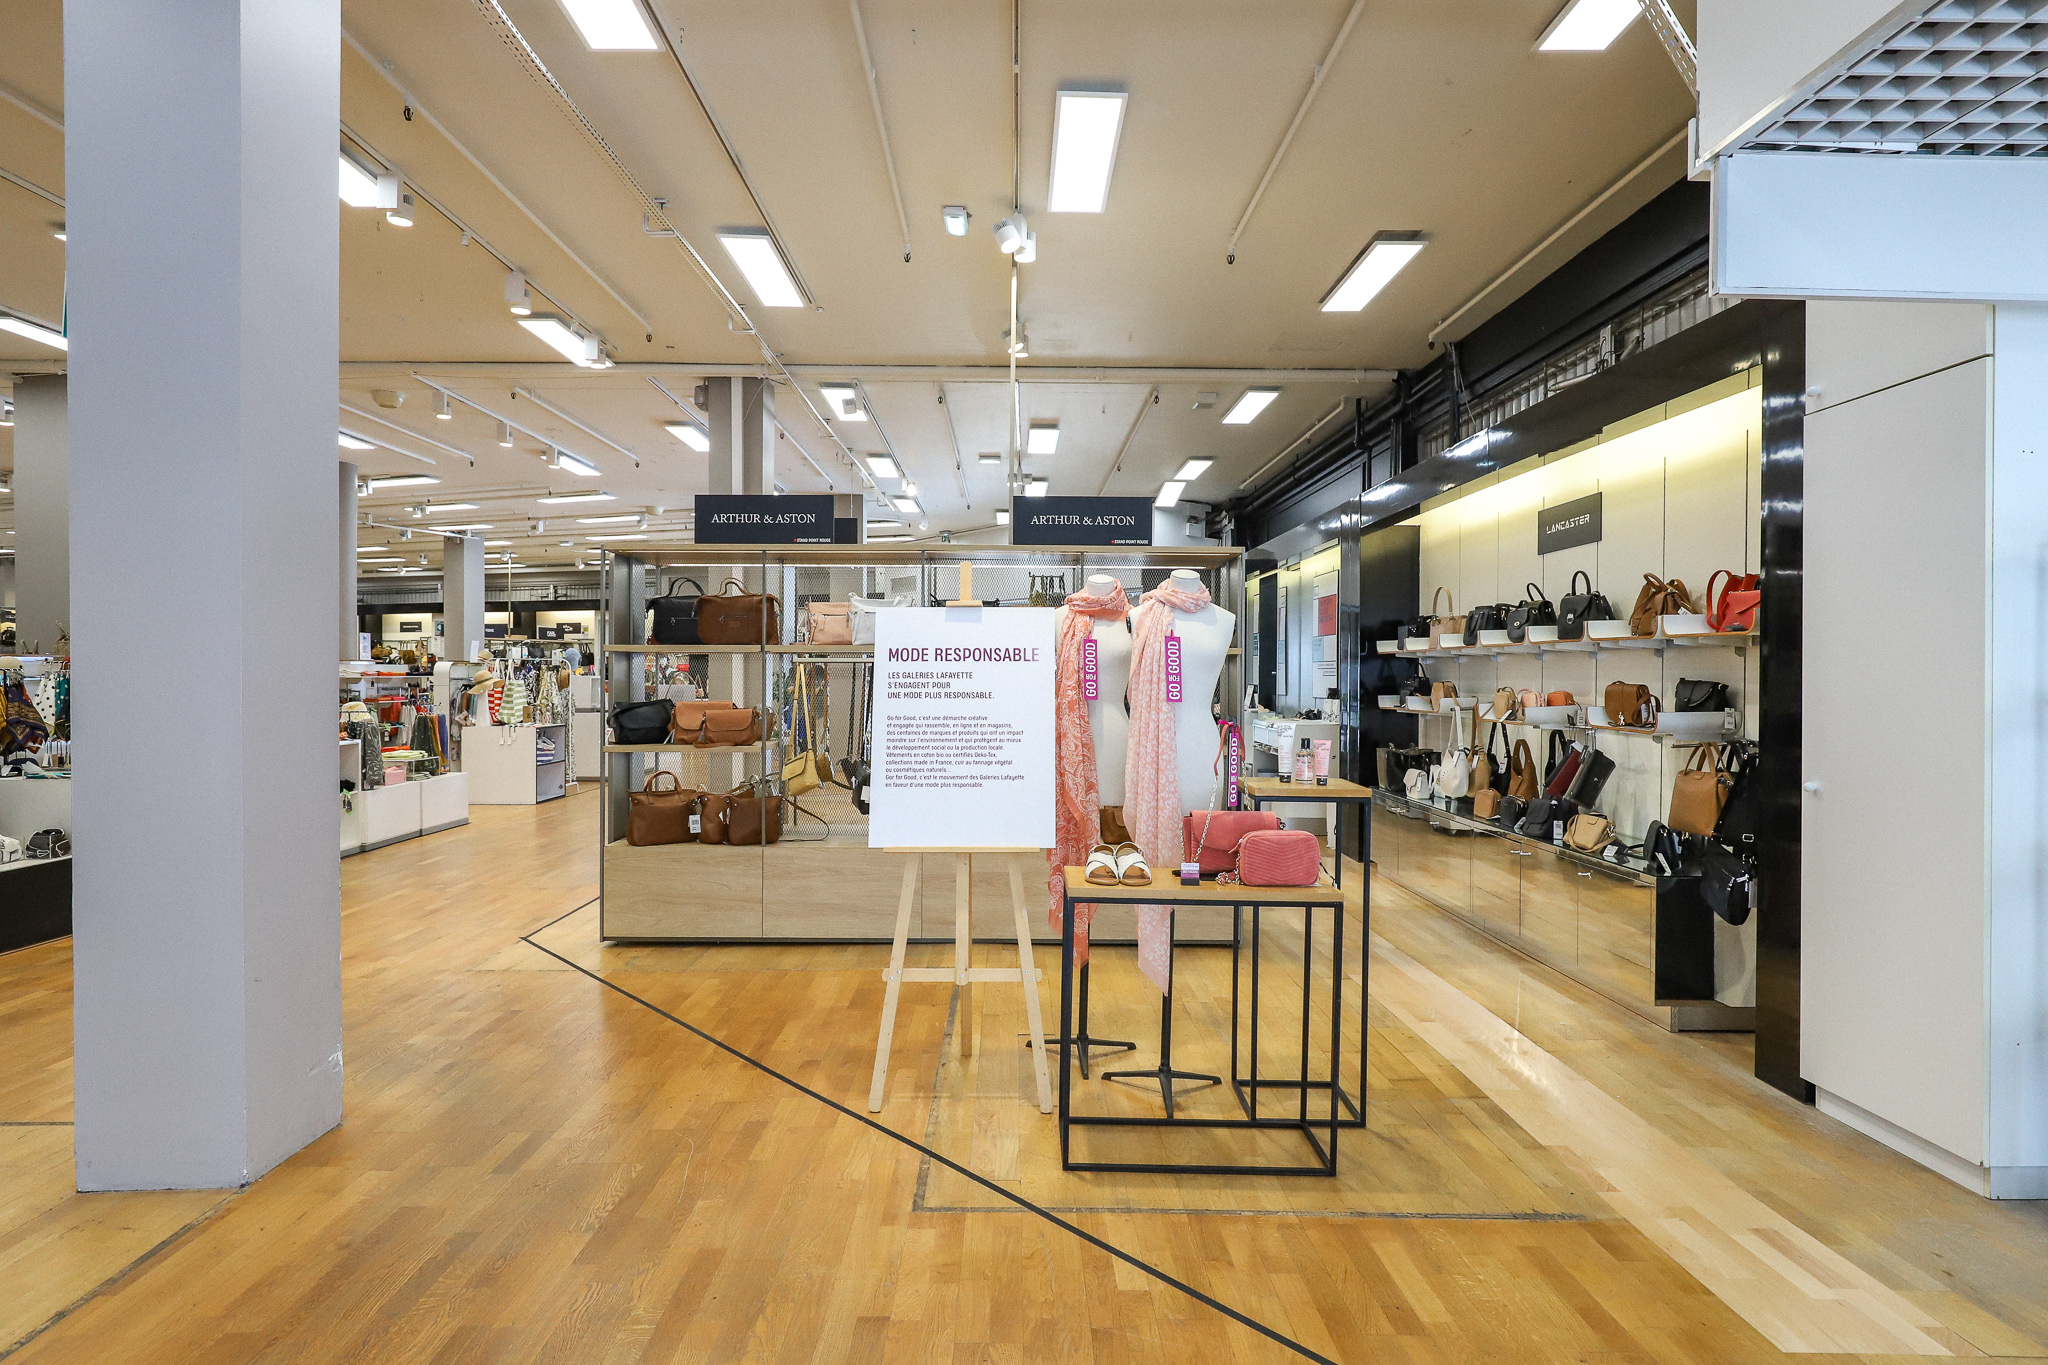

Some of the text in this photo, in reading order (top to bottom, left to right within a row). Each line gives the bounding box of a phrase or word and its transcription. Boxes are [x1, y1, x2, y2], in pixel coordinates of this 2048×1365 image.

[711, 513, 816, 523] ARTHUR & ASTON
[1030, 515, 1135, 526] ARTHUR & ASTON
[1546, 514, 1590, 534] LANCASTER
[888, 648, 1039, 662] MODE RESPONSABLE
[1085, 642, 1096, 672] GOOD
[1168, 641, 1180, 673] GOOD
[1086, 682, 1096, 697] GO
[1168, 684, 1180, 700] GO
[1230, 785, 1237, 802] GO
